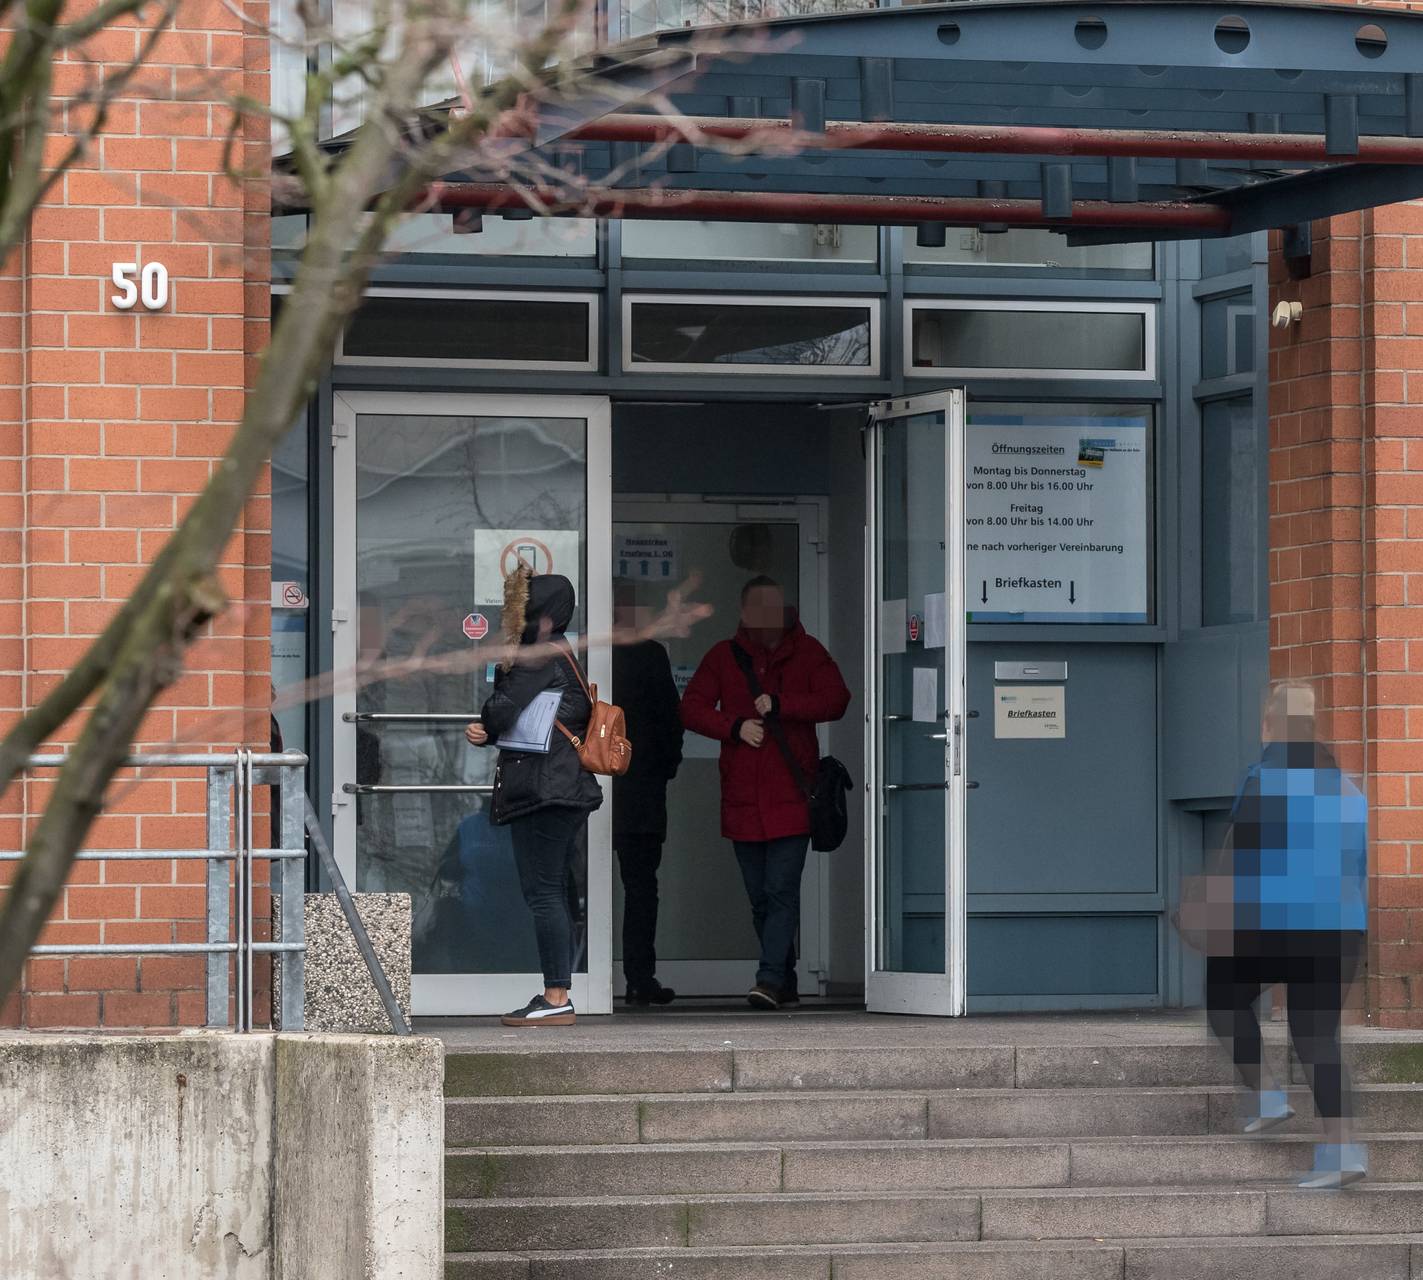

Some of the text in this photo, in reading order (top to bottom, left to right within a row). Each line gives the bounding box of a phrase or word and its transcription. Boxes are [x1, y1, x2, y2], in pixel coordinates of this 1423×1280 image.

[111, 261, 168, 309] 50
[992, 443, 1064, 455] Öffnungszeiten
[973, 466, 1086, 478] Montag bis Donnerstag
[986, 481, 1007, 490] 8.00
[1010, 481, 1028, 490] Uhr
[1030, 481, 1044, 490] bis
[1048, 482, 1073, 491] 16.00
[1077, 482, 1094, 491] Uhr
[1010, 504, 1043, 514] Freitag
[966, 517, 1094, 526] von 8.00 Uhr bis 14.00 Uhr
[982, 542, 1005, 551] nach
[1007, 543, 1057, 554] vorheriger
[1059, 543, 1124, 554] Vereinbarung
[995, 577, 1061, 588] Briefkasten
[1008, 710, 1056, 719] Briefkasten
